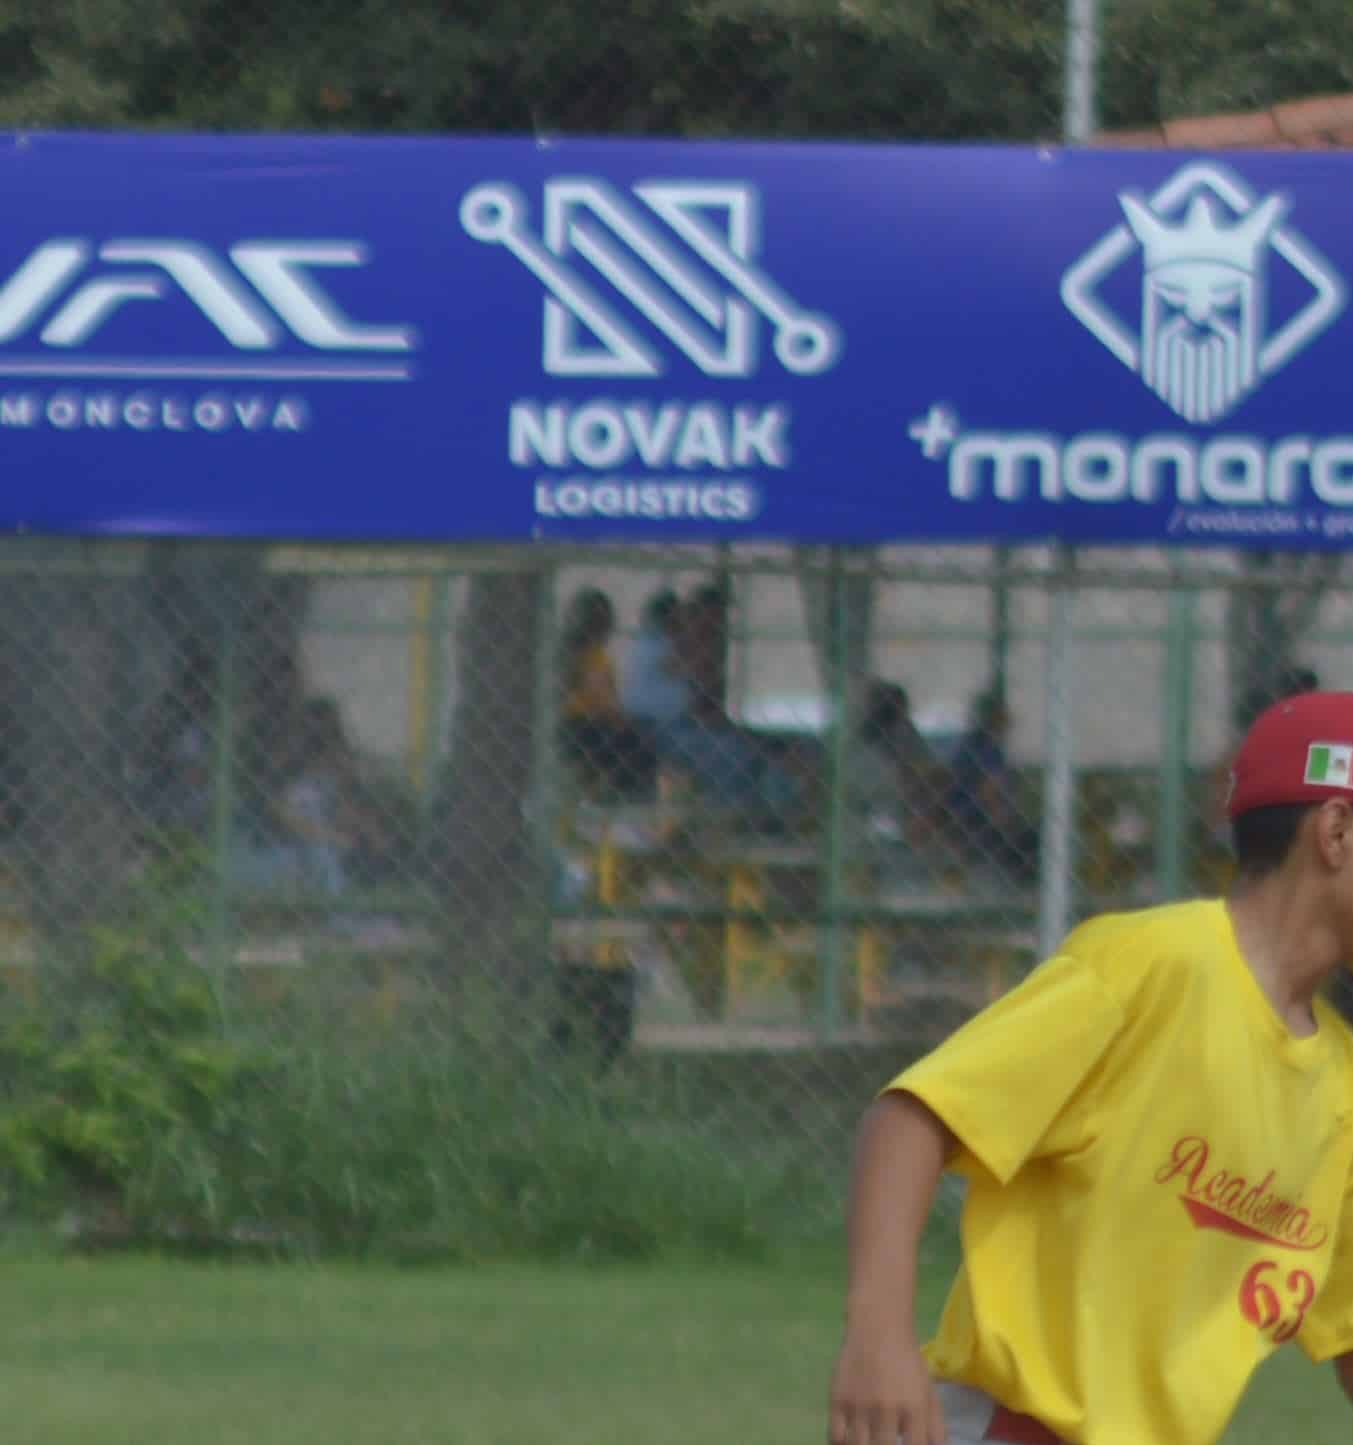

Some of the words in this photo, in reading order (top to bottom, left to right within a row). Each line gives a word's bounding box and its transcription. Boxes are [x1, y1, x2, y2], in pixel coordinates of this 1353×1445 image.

[0, 394, 303, 430] MONCLOVA
[510, 401, 785, 468] NOVAK
[535, 479, 754, 519] LOGISTICS
